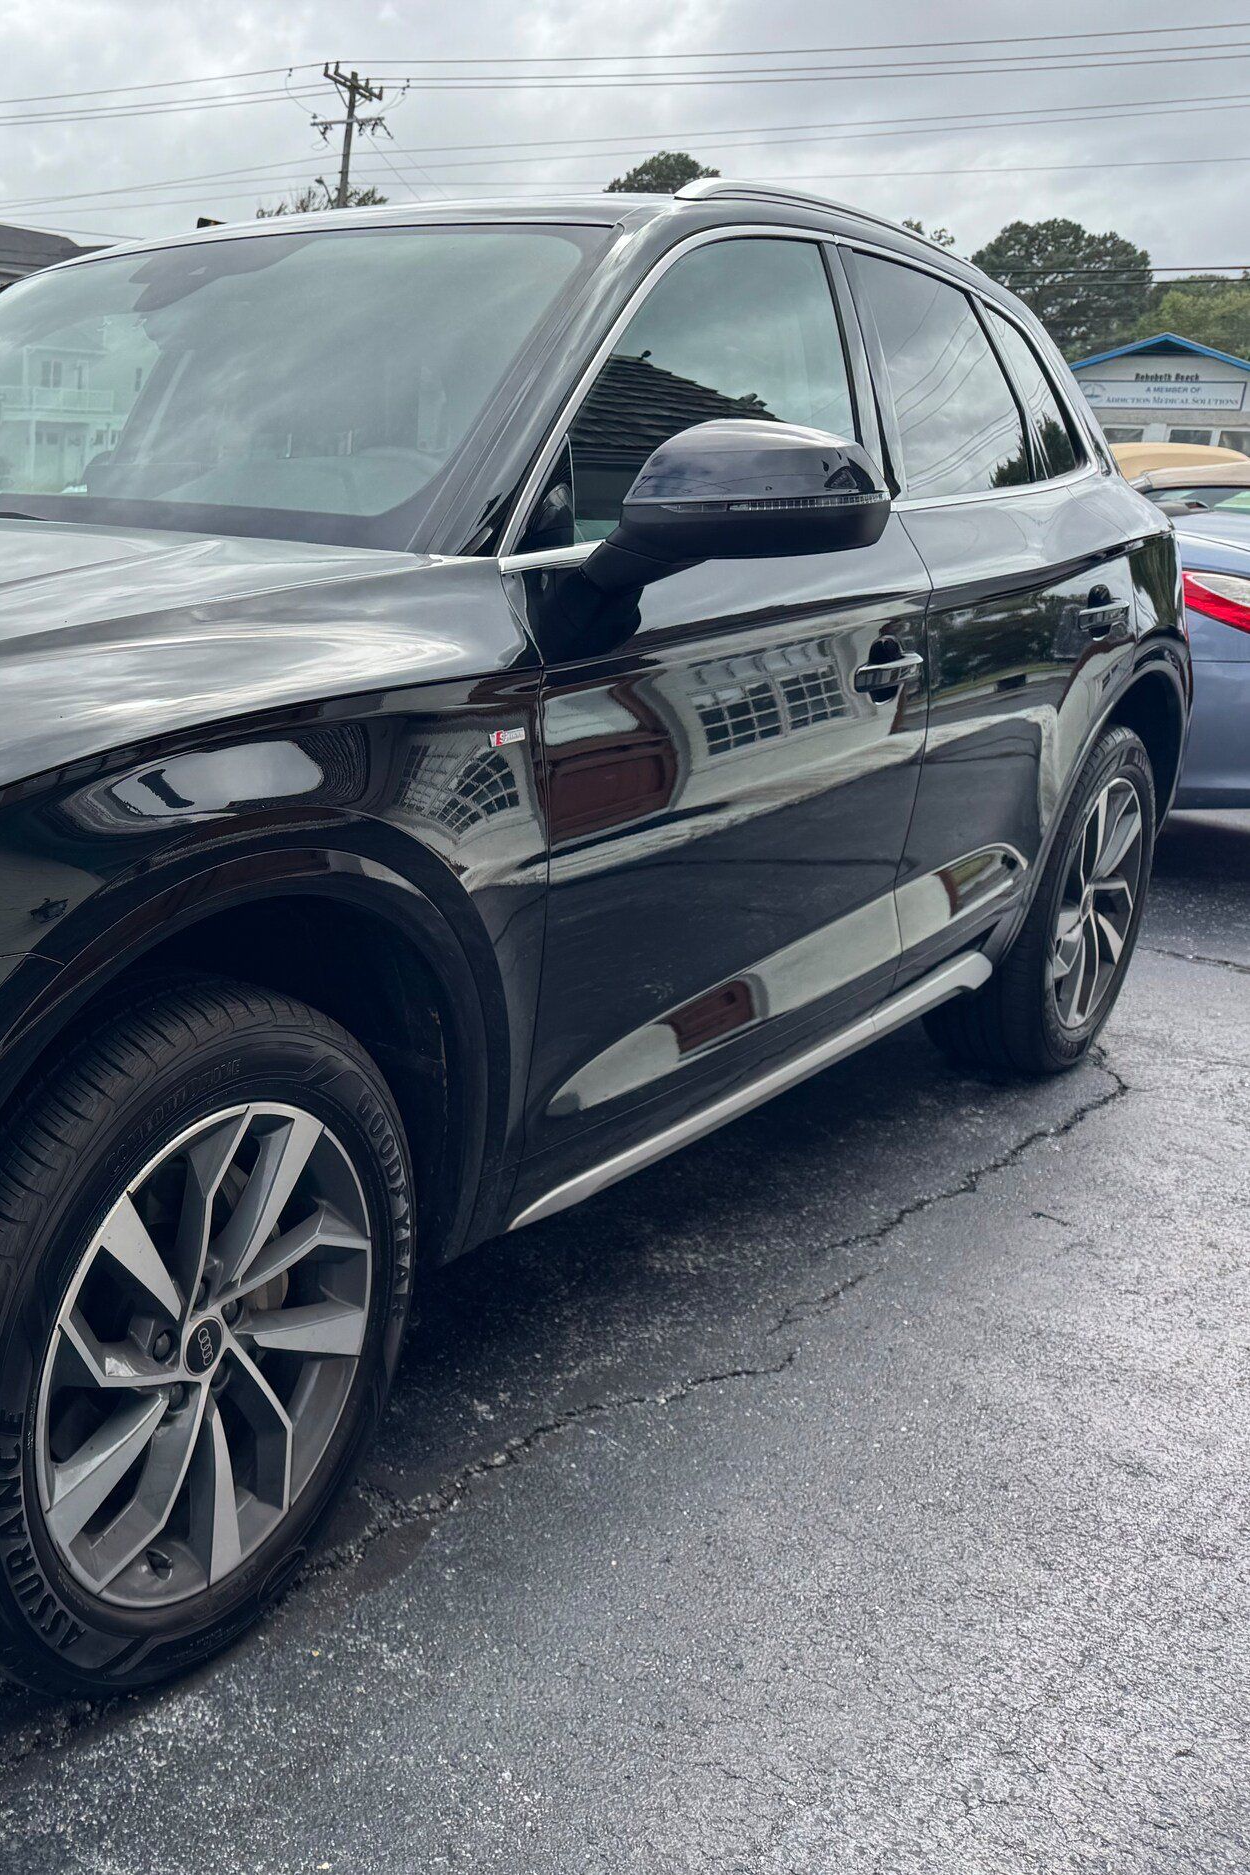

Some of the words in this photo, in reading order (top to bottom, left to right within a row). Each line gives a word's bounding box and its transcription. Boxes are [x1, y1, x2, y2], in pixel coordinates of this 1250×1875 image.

[1106, 396, 1150, 404] ADDICTION
[1152, 396, 1189, 404] MEDICAL
[1192, 397, 1239, 405] SOLUTIONS
